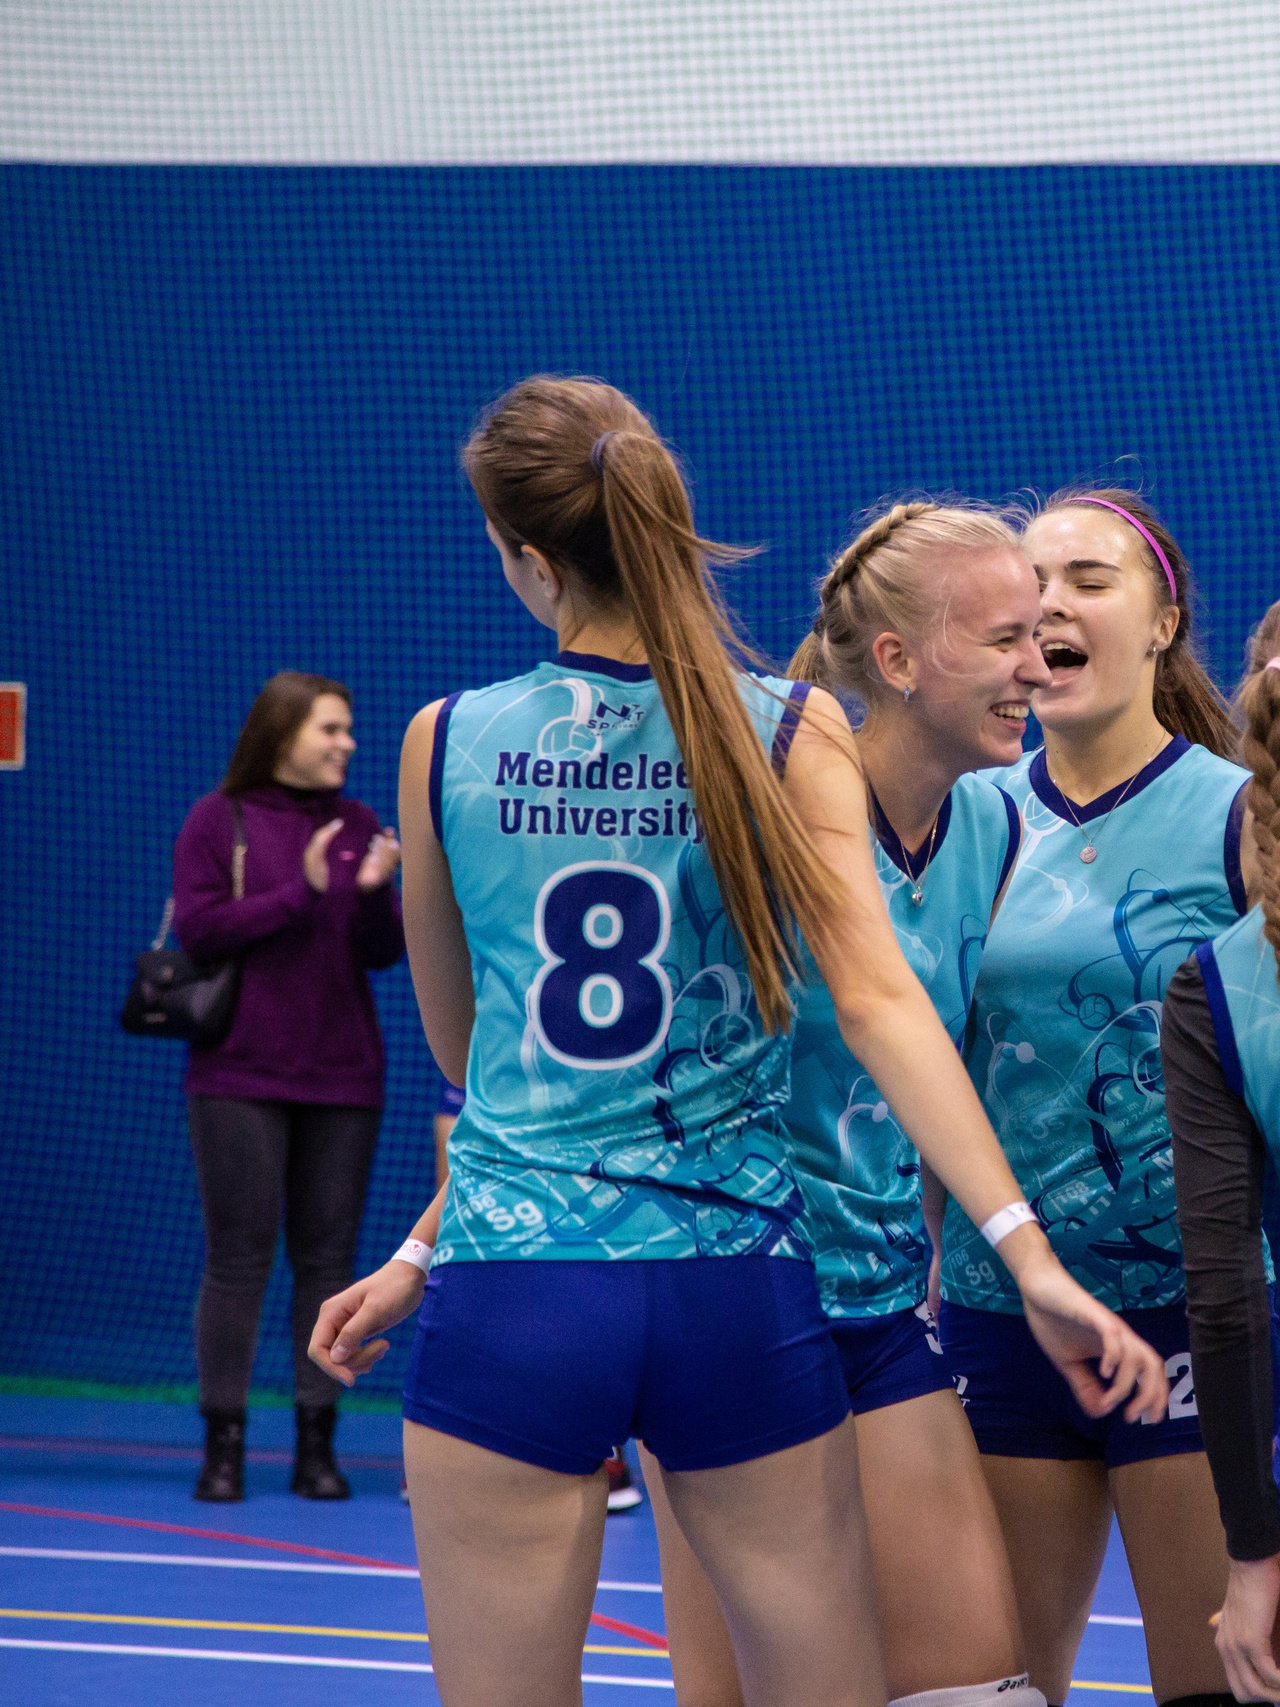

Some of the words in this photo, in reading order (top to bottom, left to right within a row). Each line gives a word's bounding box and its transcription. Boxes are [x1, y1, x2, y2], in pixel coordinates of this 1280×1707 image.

[495, 751, 694, 790] Mendelee
[534, 861, 672, 1070] 8
[486, 1200, 543, 1231] Sg
[950, 1249, 969, 1270] 106
[965, 1260, 996, 1286] Sg
